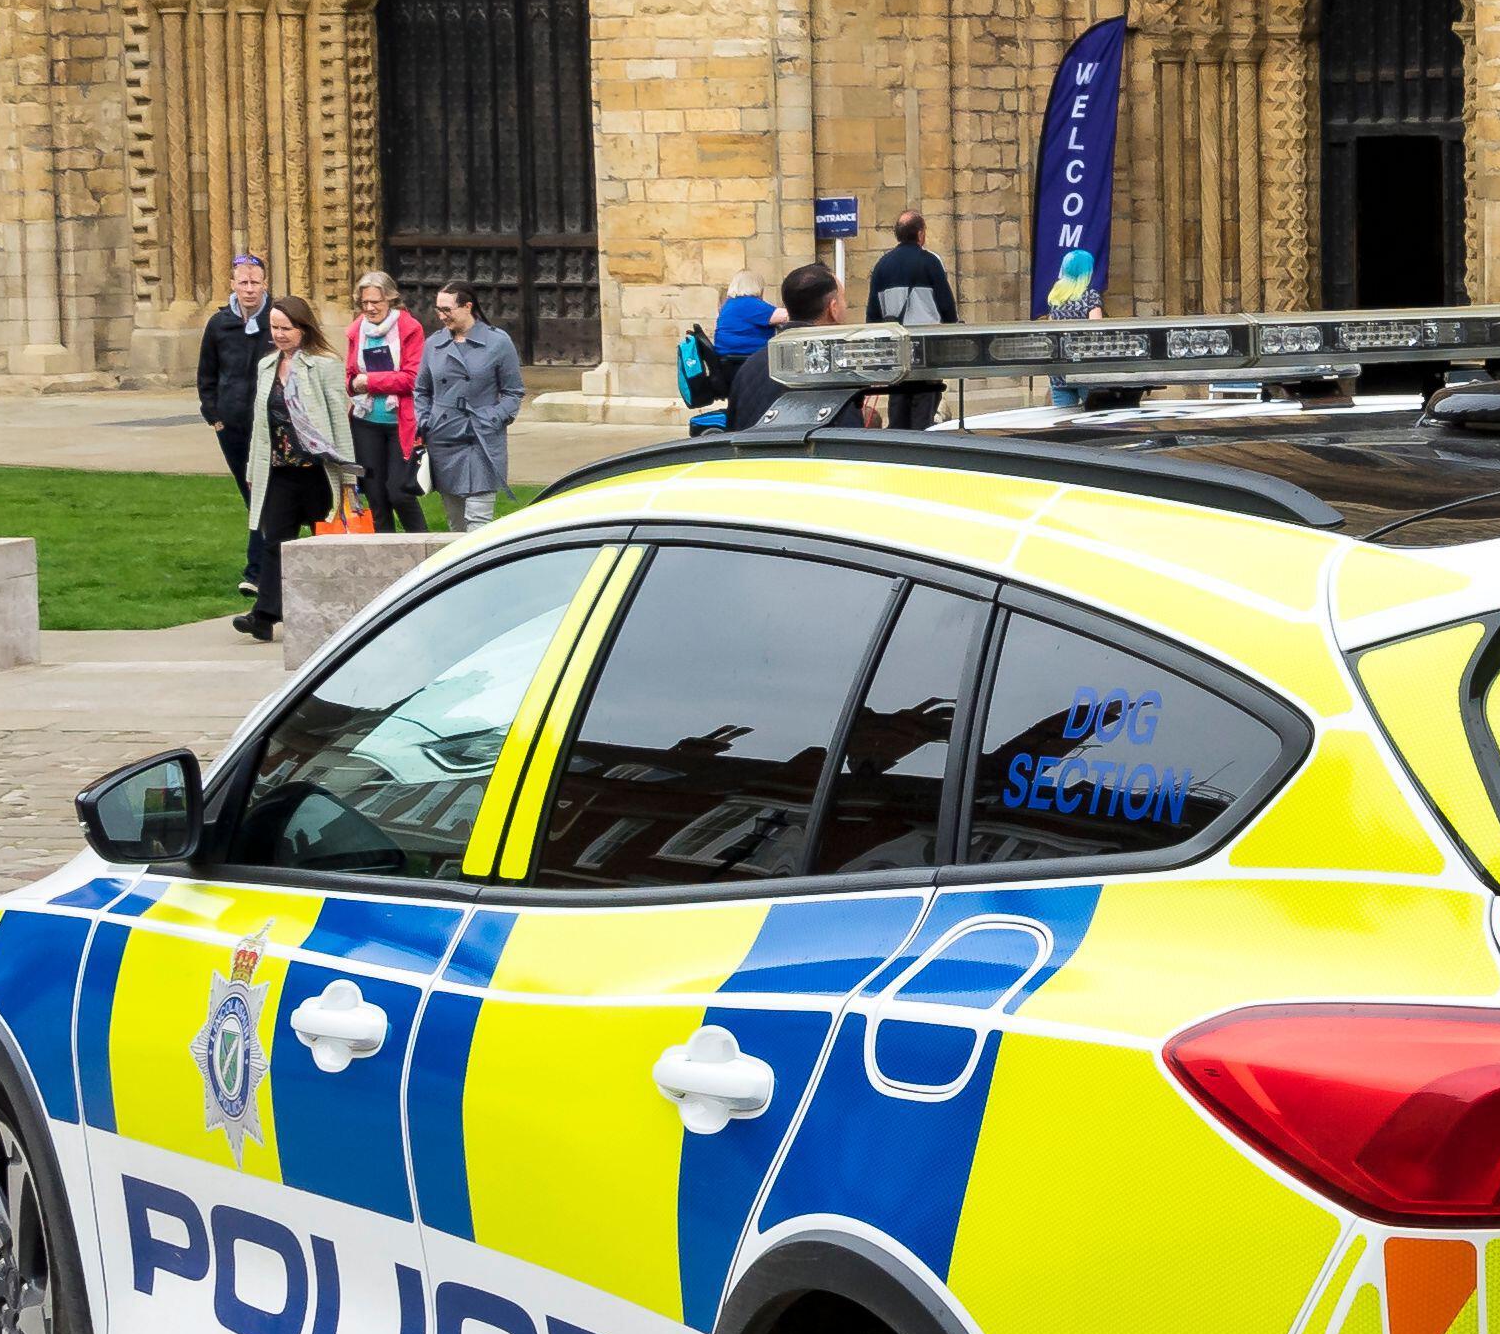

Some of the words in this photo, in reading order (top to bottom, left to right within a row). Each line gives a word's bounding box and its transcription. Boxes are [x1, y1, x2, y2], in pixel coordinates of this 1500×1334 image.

[1056, 62, 1099, 267] WELCOM
[815, 213, 856, 223] ENTRANCE
[1062, 685, 1163, 745] DOG
[1002, 752, 1193, 824] SECTION
